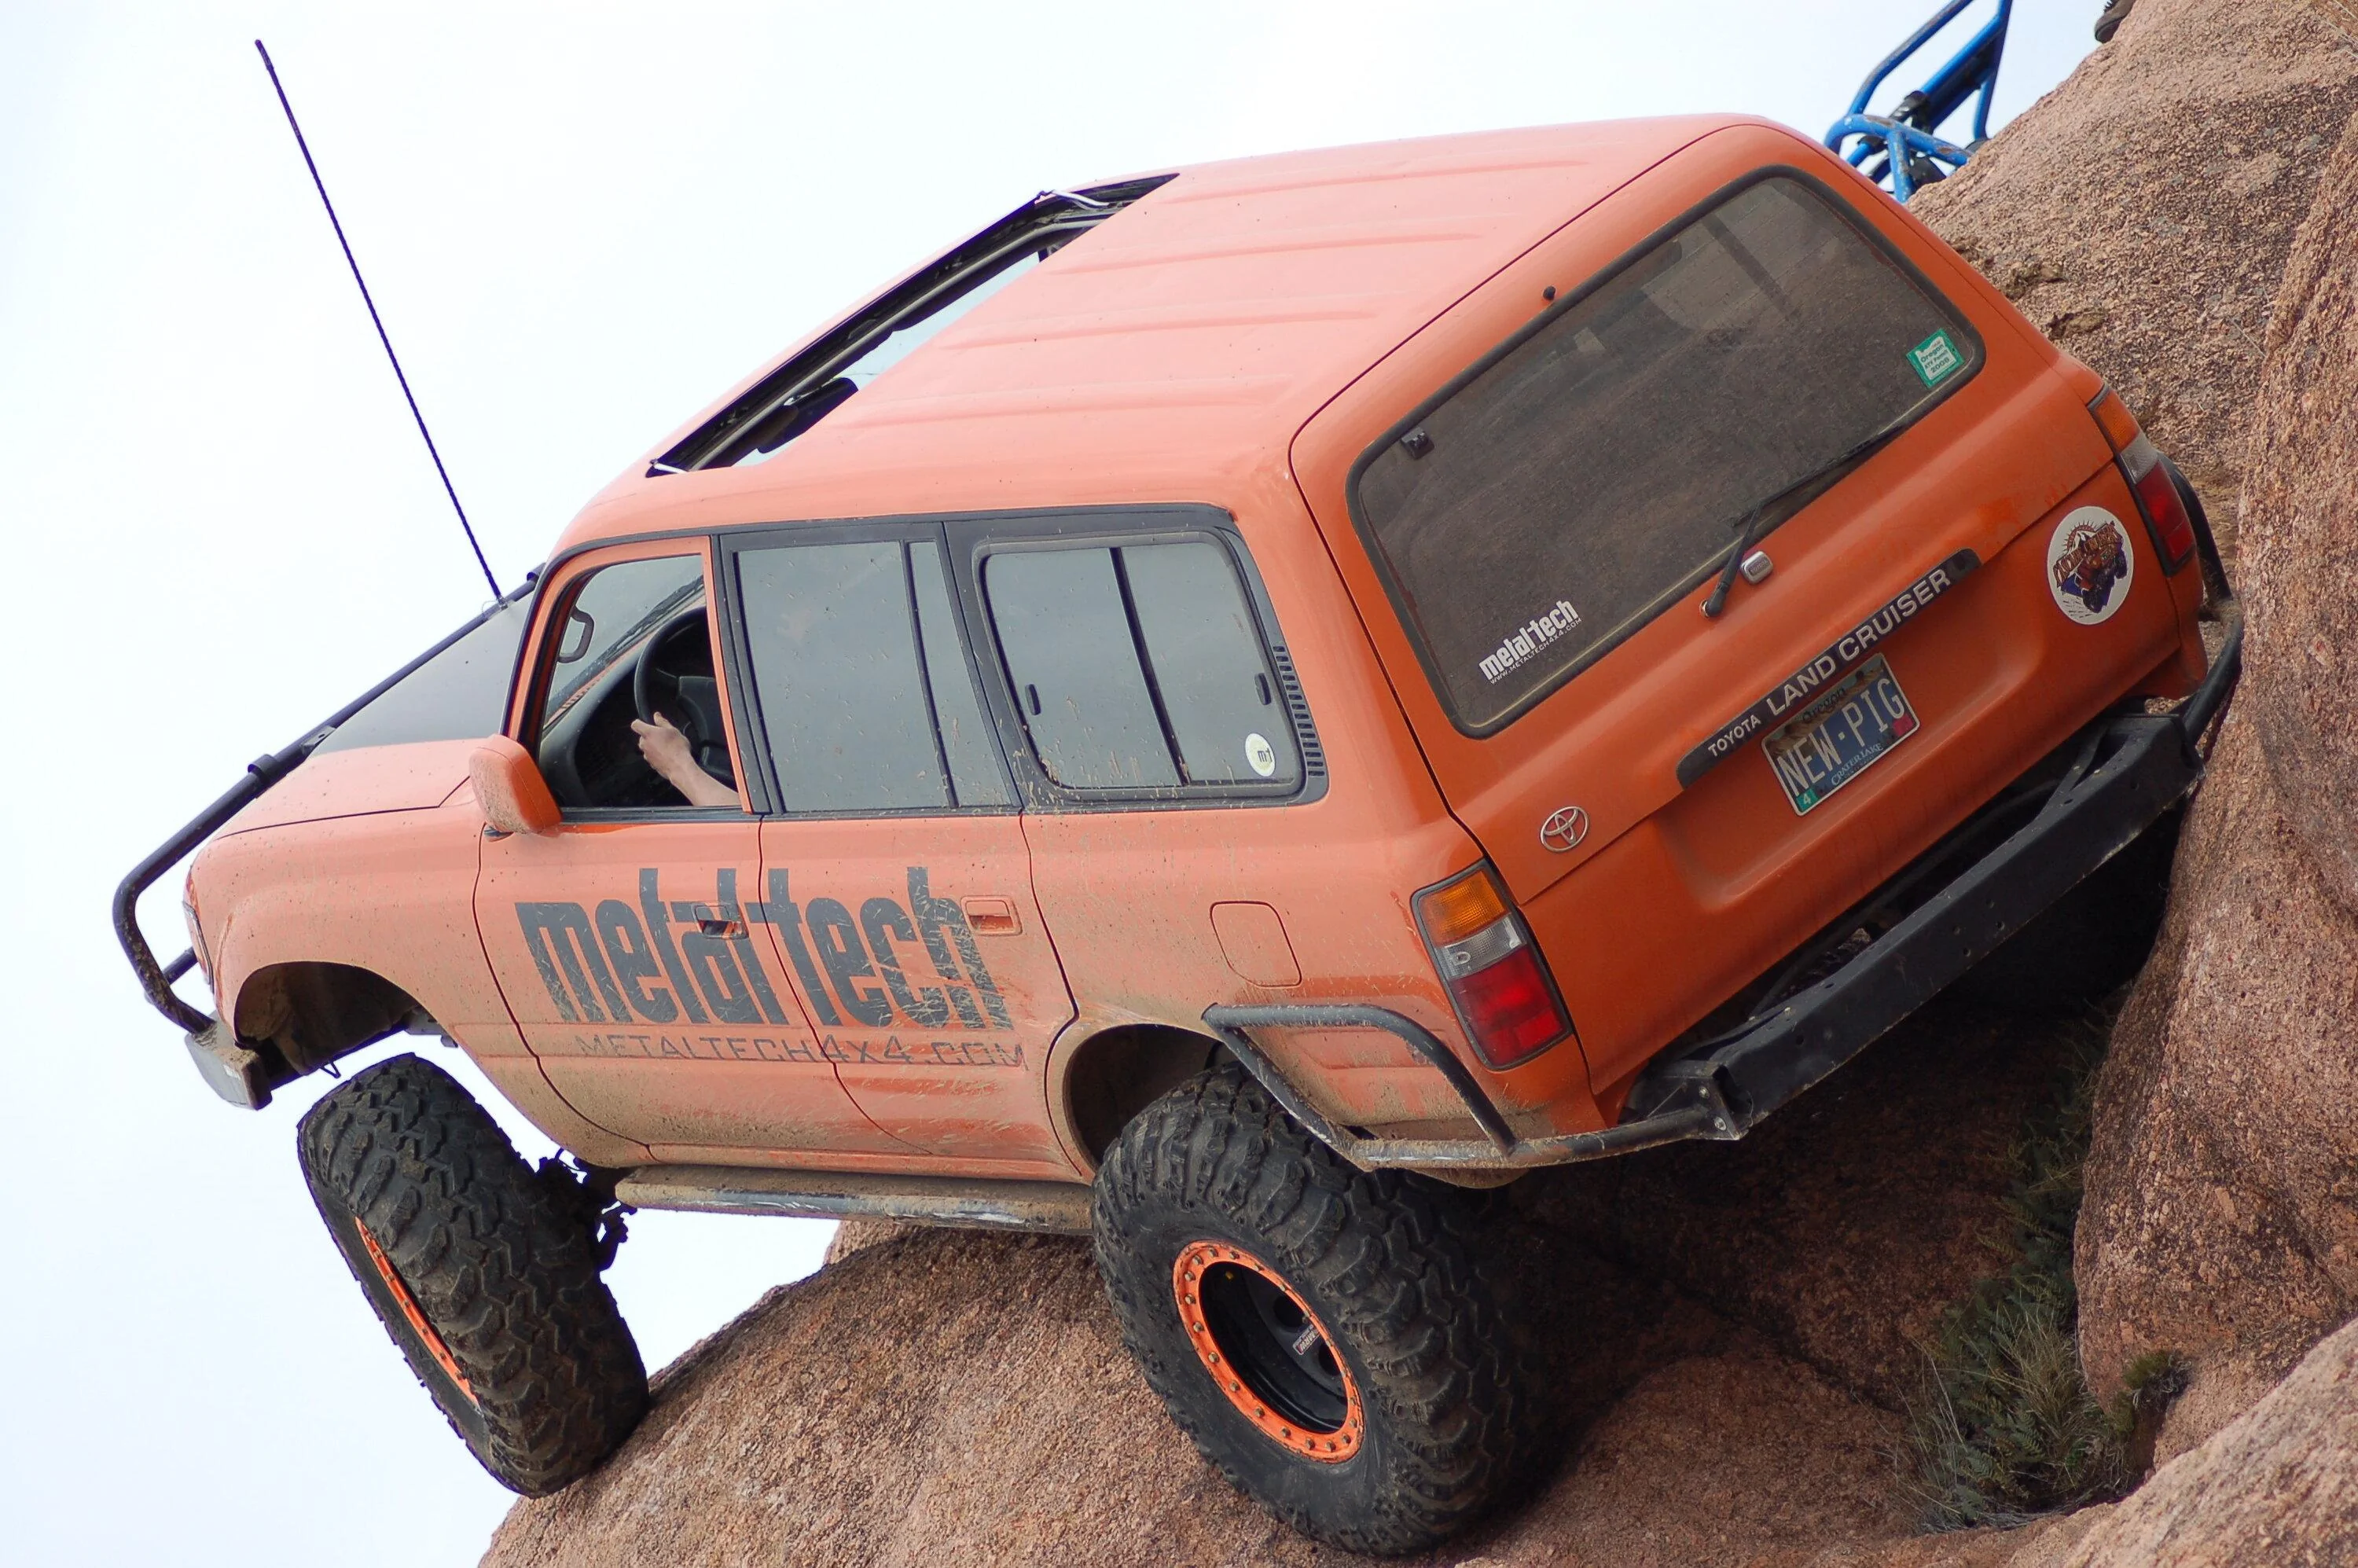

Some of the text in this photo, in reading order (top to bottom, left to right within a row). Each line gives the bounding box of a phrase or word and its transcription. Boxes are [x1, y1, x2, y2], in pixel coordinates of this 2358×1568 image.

[1707, 568, 1951, 757] TOYOTA LAND CRUISER
[1831, 755, 1862, 785] CRATER
[1860, 744, 1884, 758] LAKE
[1803, 792, 1812, 805] 4
[575, 1033, 1030, 1071] METALTECH4X4.COM
